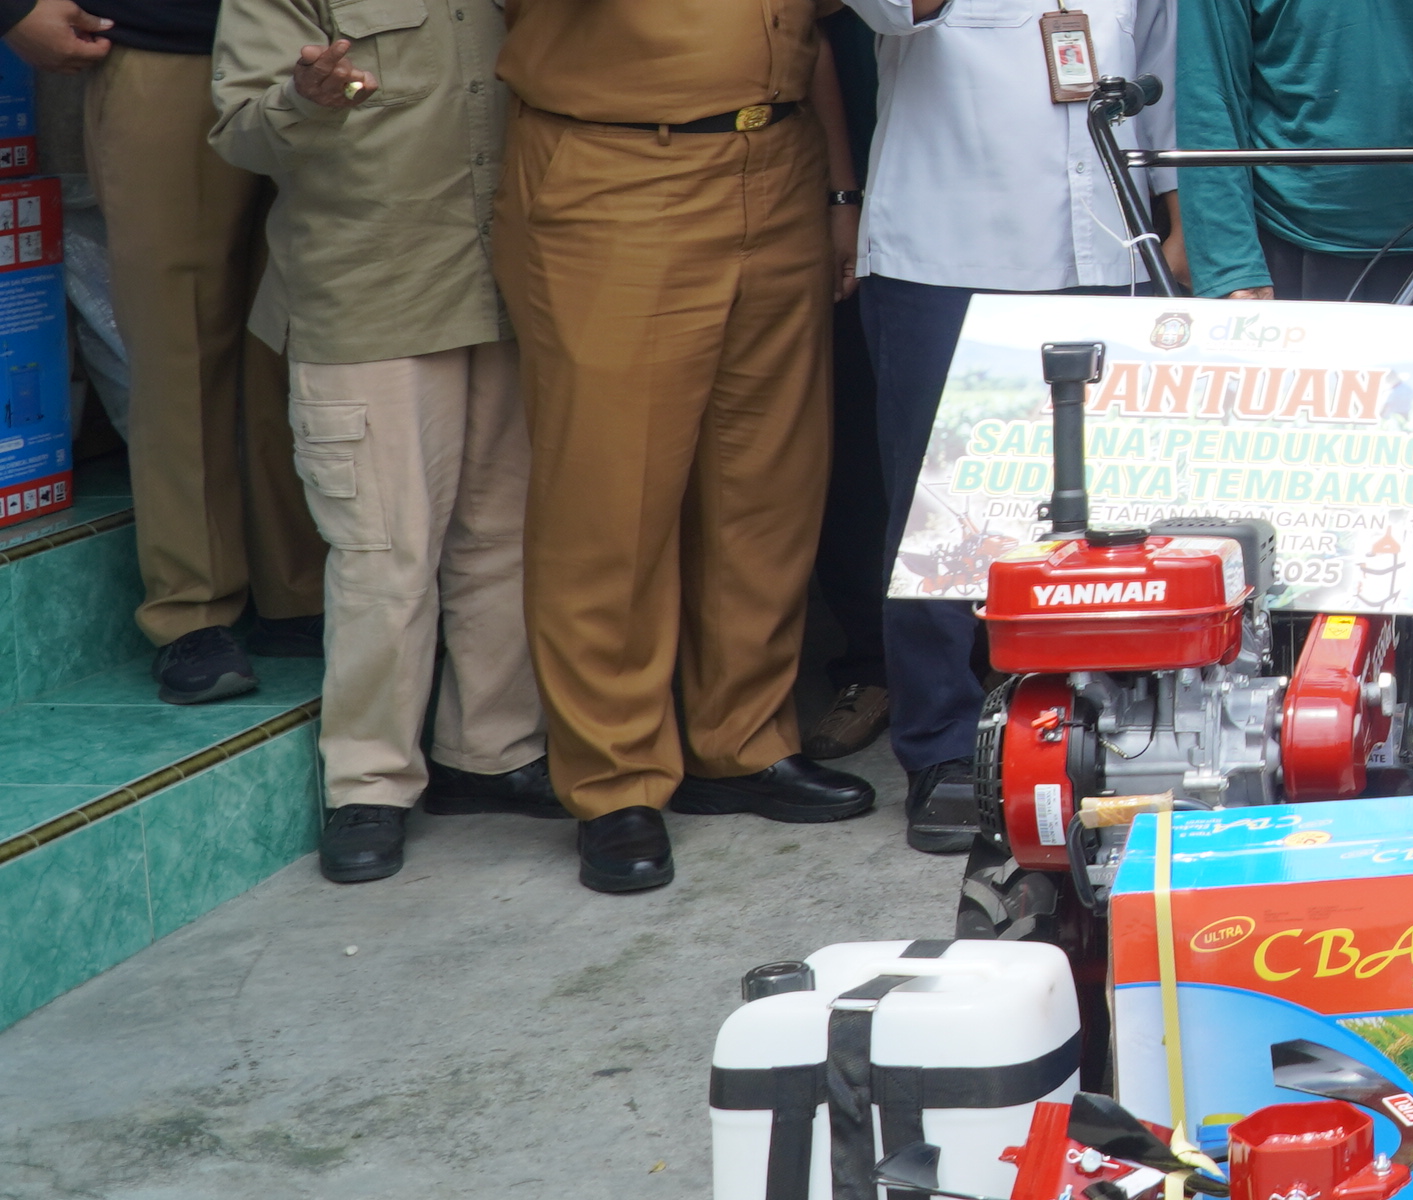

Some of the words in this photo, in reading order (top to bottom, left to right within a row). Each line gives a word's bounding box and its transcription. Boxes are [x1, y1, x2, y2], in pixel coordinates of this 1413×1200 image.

[1045, 361, 1389, 423] ANTUAN
[970, 421, 1149, 459] SARNA
[988, 501, 1045, 519] DINA
[1089, 503, 1224, 523] ETAHANAN
[1338, 512, 1386, 529] DAN
[1033, 581, 1166, 606] YANMAR
[1204, 924, 1244, 944] ULTRA
